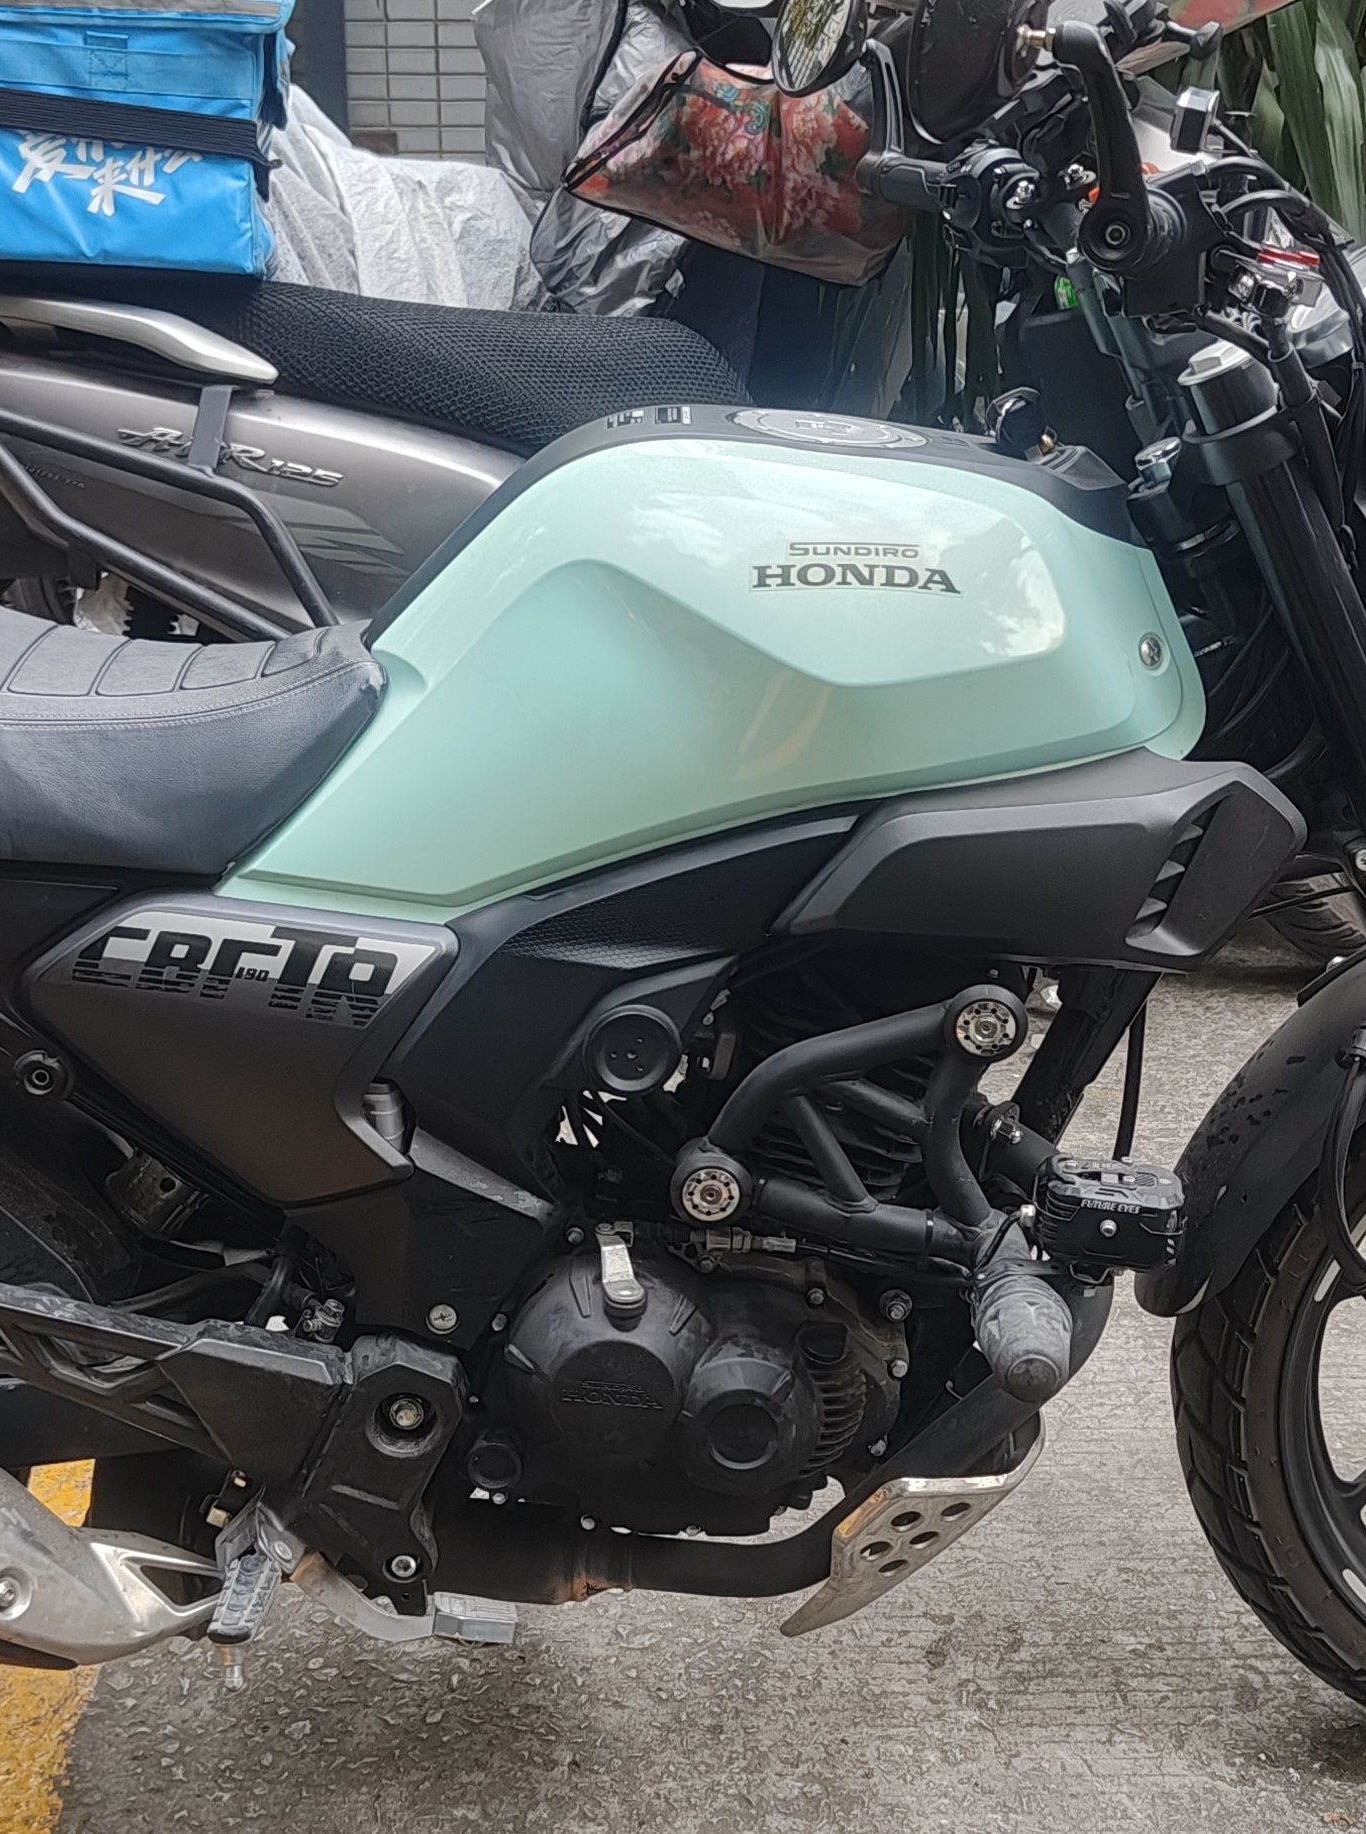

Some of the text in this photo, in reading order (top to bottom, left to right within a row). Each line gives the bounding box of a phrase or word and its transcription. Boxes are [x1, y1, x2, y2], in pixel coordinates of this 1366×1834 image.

[789, 541, 920, 559] SUNDIRO
[752, 563, 961, 595] HONDA
[1081, 1200, 1142, 1215] FUTURE EYES
